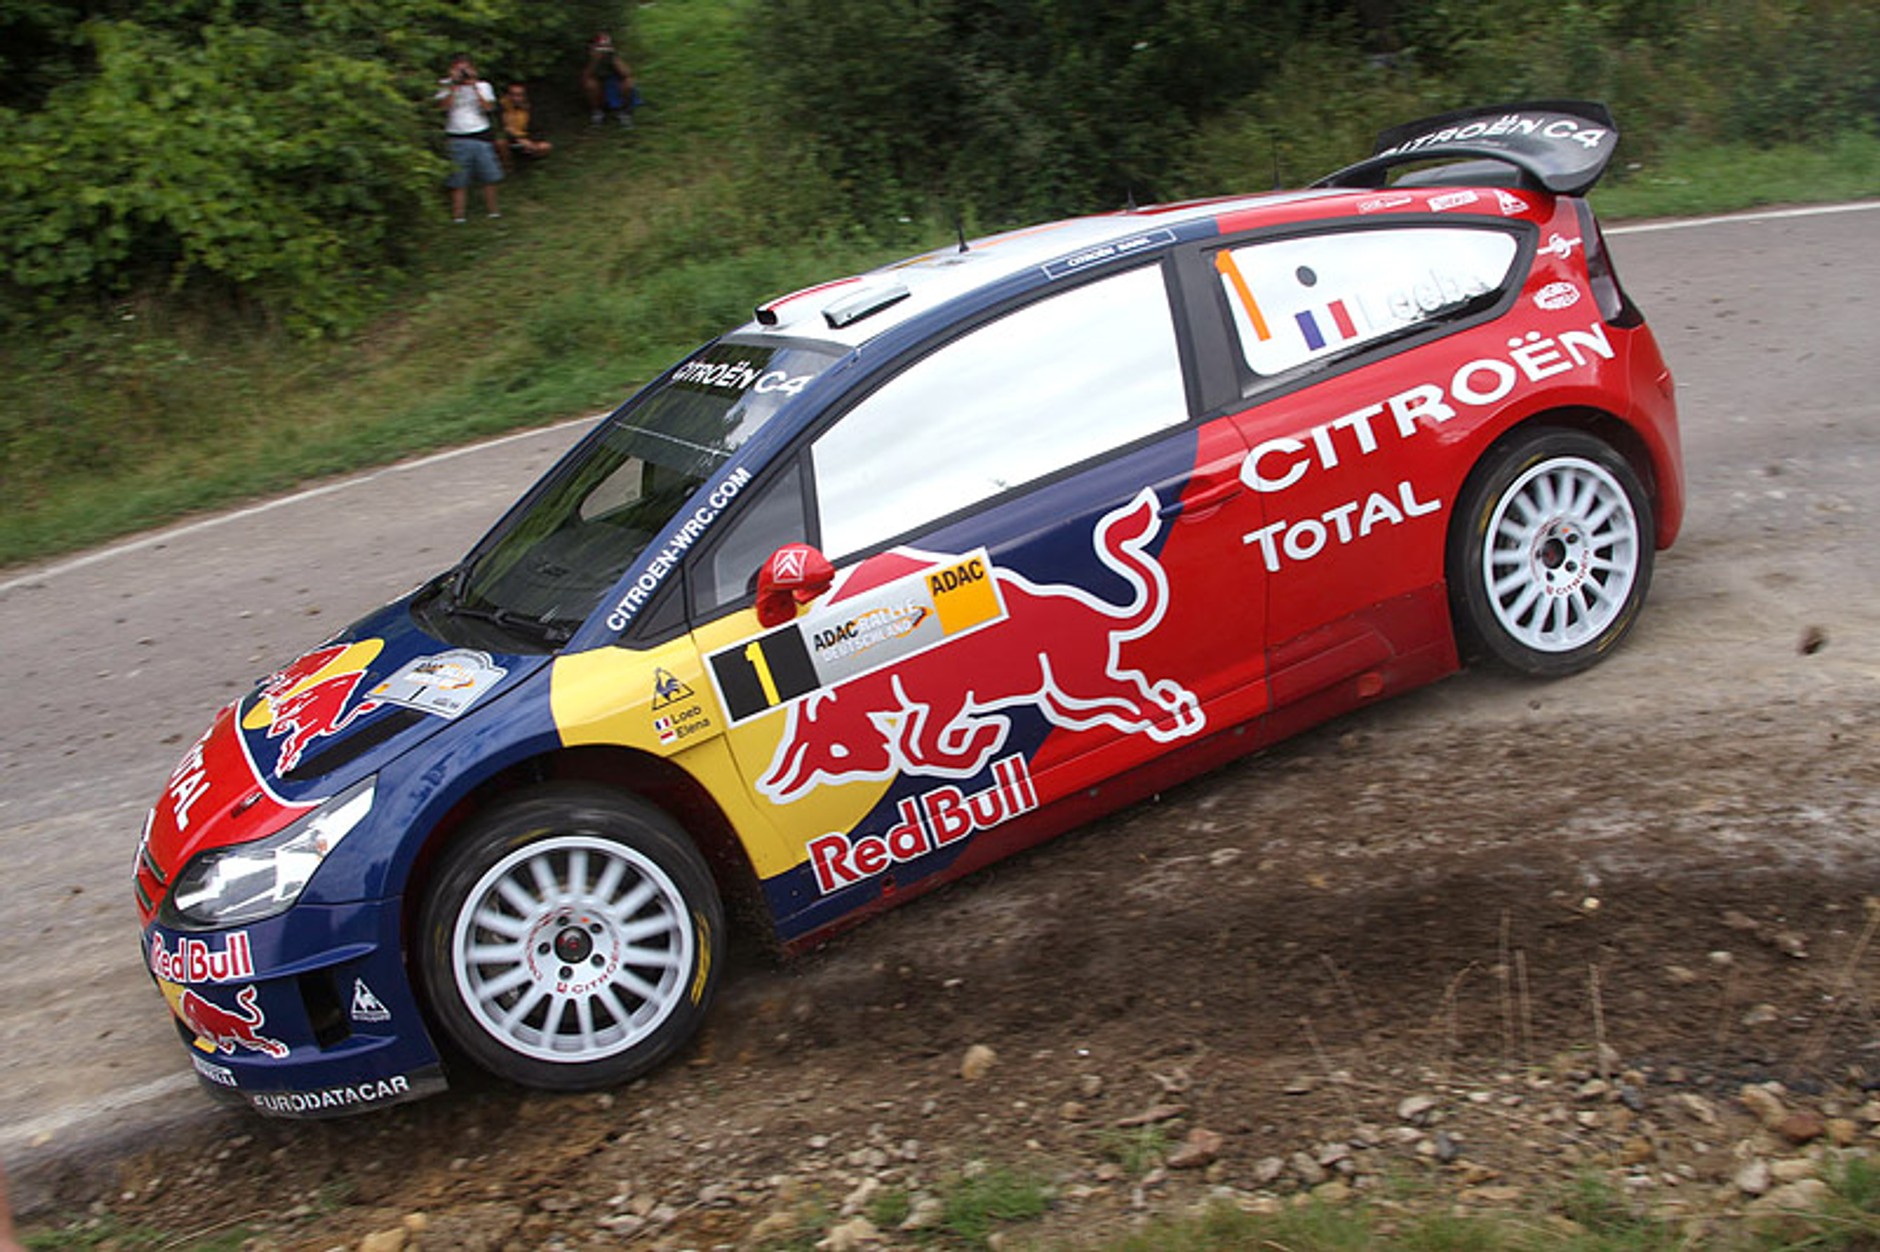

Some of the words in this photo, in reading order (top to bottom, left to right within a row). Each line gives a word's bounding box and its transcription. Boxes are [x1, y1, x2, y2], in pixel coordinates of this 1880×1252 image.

[1214, 248, 1272, 342] 1
[671, 359, 763, 390] CITROËN
[754, 370, 815, 397] C4
[1239, 322, 1615, 493] CITROËN
[606, 466, 753, 631] CITROEN-WRC.COM
[1242, 480, 1443, 573] TOTAL
[929, 559, 985, 597] ADAC
[813, 619, 860, 652] ADAC
[744, 640, 782, 707] 1
[807, 792, 931, 895] Red
[920, 752, 1039, 849] Bull
[152, 931, 188, 983] Red
[187, 930, 254, 984] Bull
[253, 1074, 410, 1113] EURODATACAR
